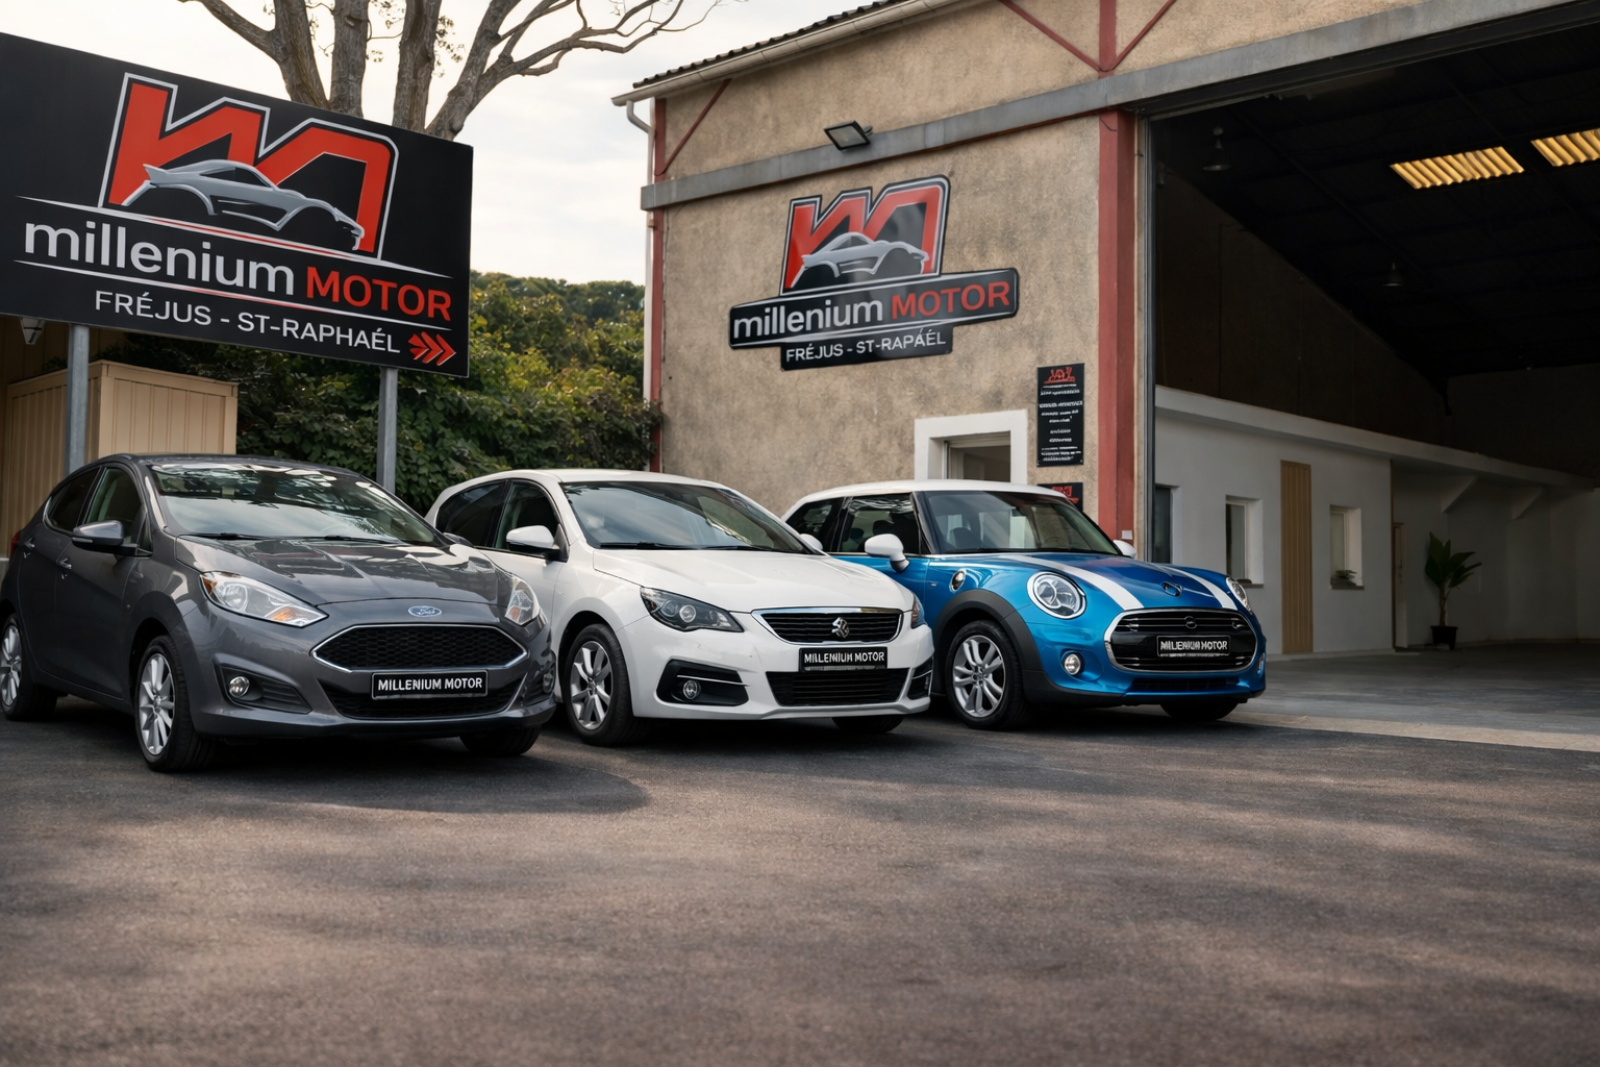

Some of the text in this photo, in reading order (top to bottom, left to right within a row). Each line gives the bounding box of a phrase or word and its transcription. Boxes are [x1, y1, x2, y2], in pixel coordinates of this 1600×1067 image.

[25, 221, 452, 321] millenium MOTOR
[95, 290, 212, 326] FRÉJUS
[237, 313, 401, 354] ST-RAPHAÉL
[733, 281, 1010, 339] millenium MOTOR
[786, 343, 844, 362] FRÉJUS
[855, 651, 885, 662] MOTOR
[378, 677, 483, 691] MILLENIUM MOTOR
